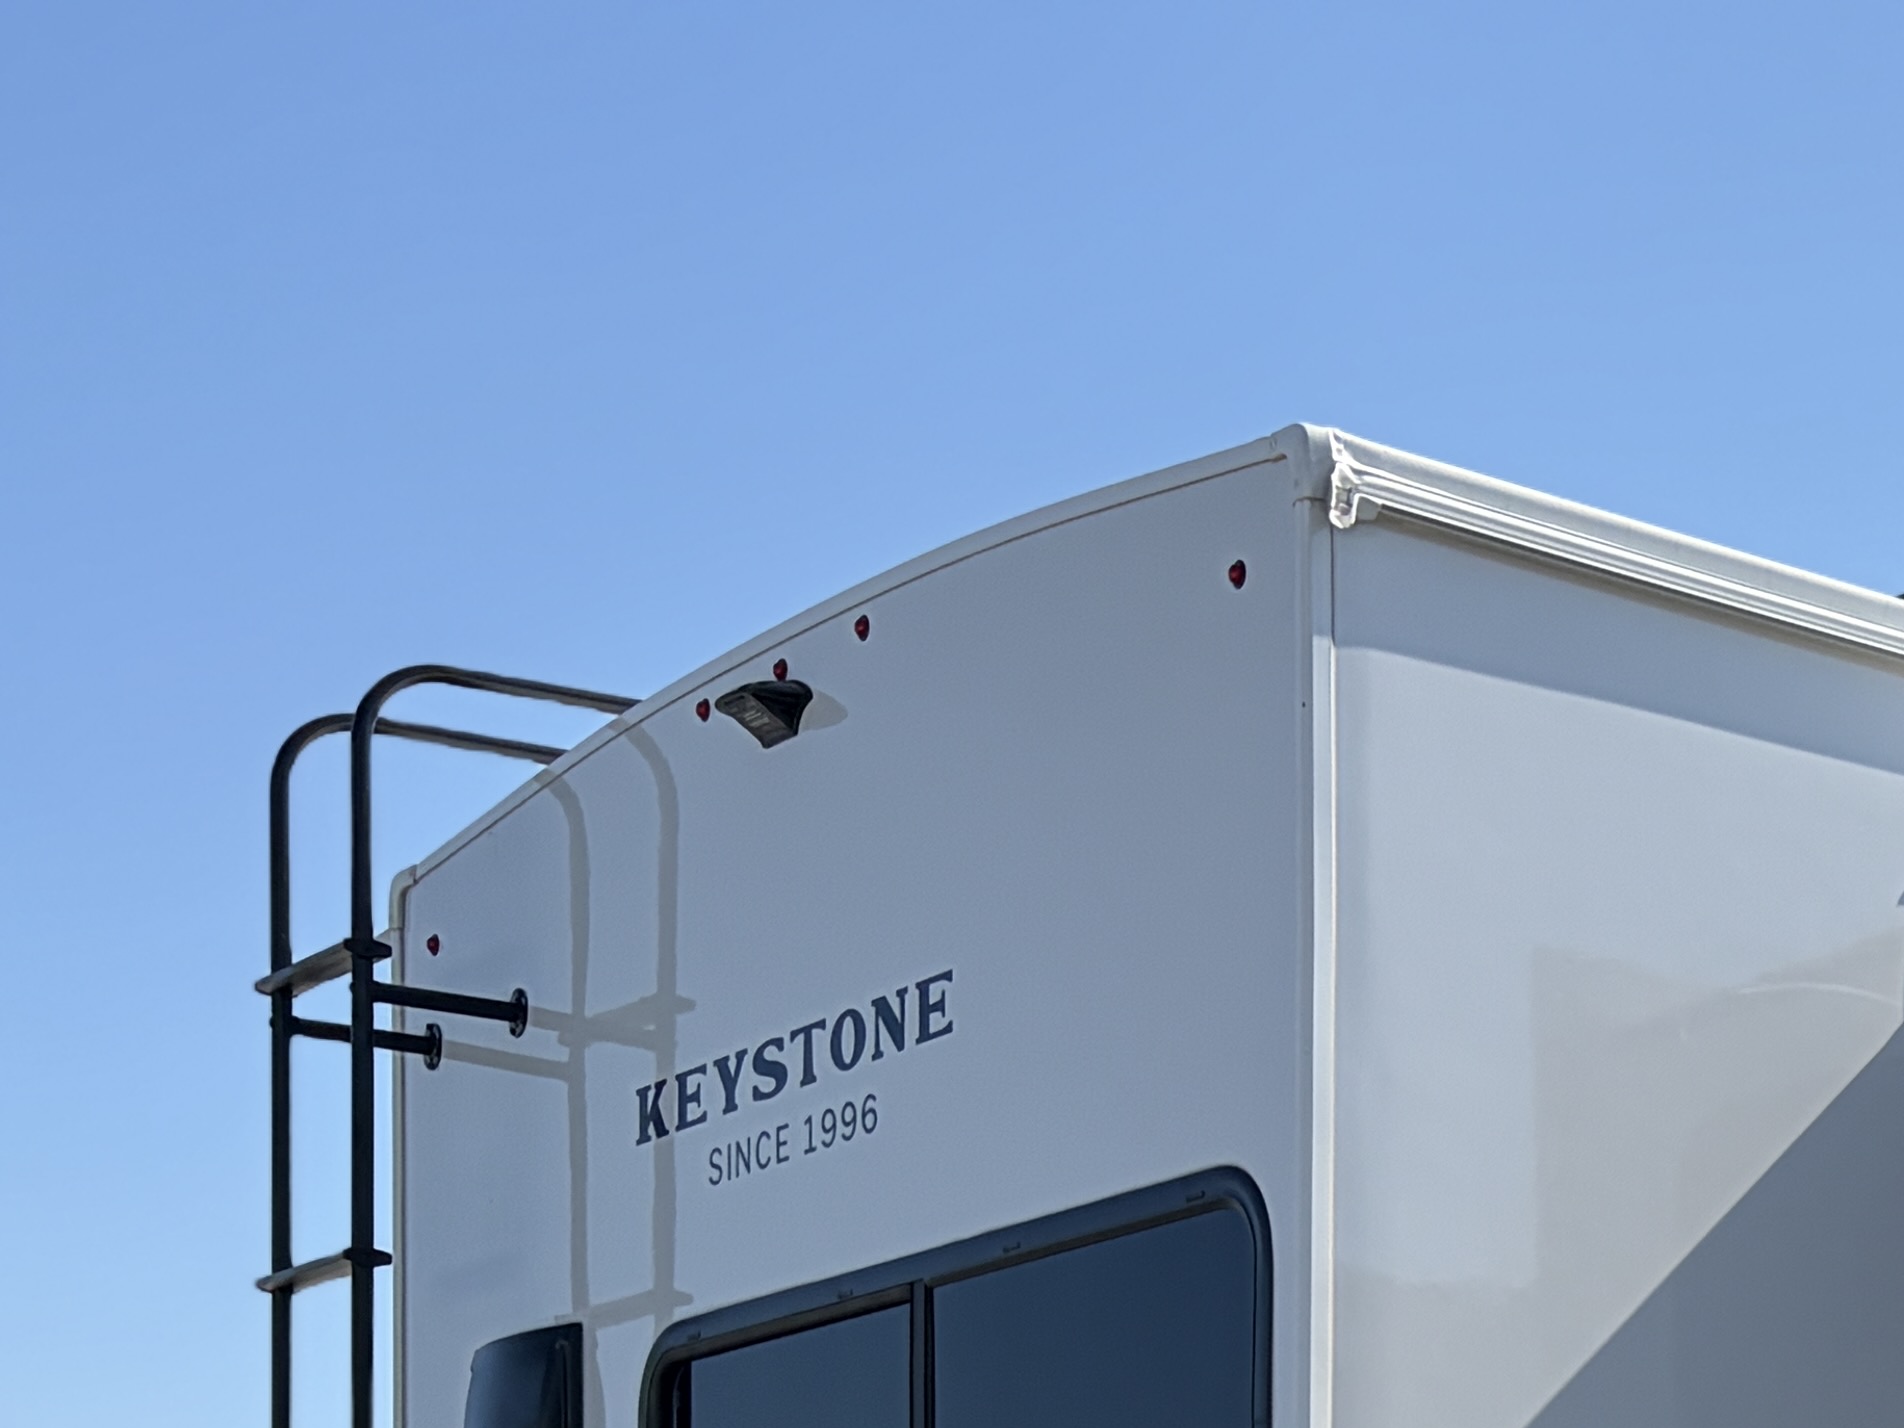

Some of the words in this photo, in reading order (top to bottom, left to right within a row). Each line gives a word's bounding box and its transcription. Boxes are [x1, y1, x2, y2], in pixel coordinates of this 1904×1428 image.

[635, 968, 954, 1147] KEYSTONE
[708, 1122, 791, 1186] SINCE
[803, 1092, 878, 1155] 1996
